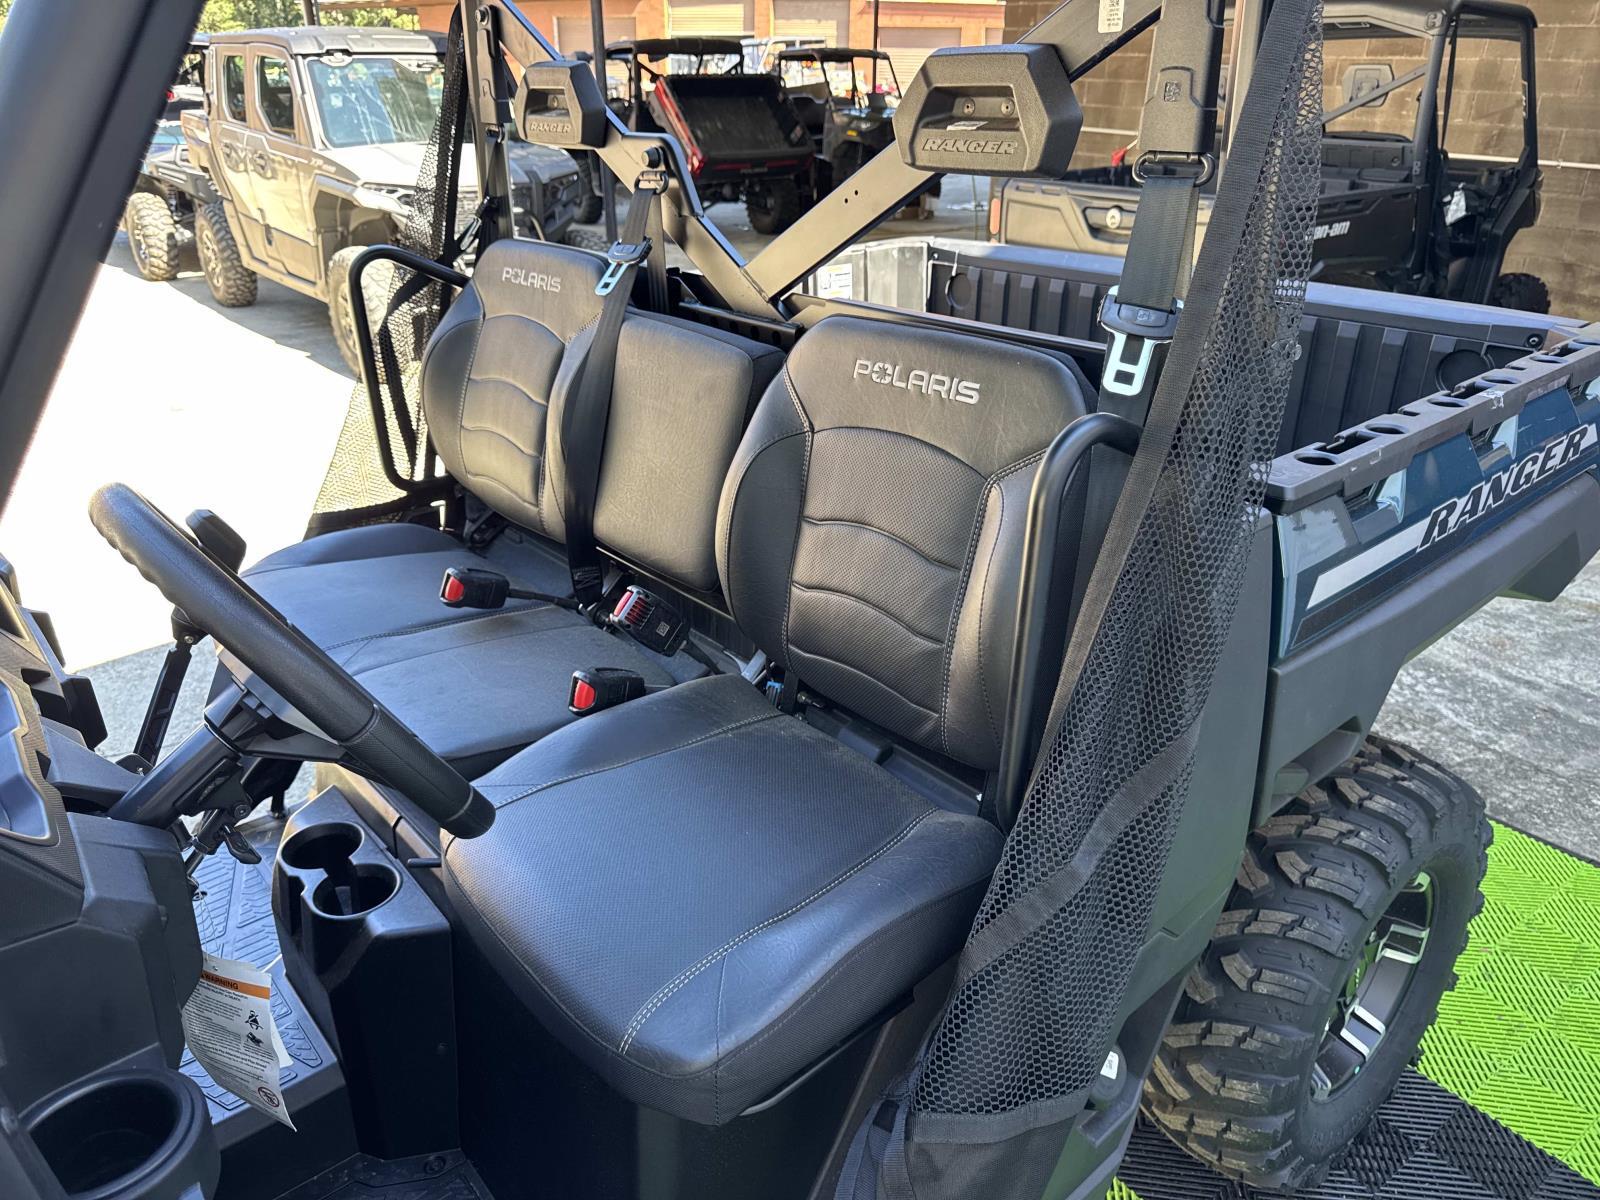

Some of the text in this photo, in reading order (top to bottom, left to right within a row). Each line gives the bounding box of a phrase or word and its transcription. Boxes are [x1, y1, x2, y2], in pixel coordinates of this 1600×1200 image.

[530, 121, 572, 134] RANGER
[922, 138, 1018, 155] RANGER
[502, 267, 561, 293] POLARIS
[853, 359, 981, 405] POLARIS
[1417, 424, 1589, 552] RANGER
